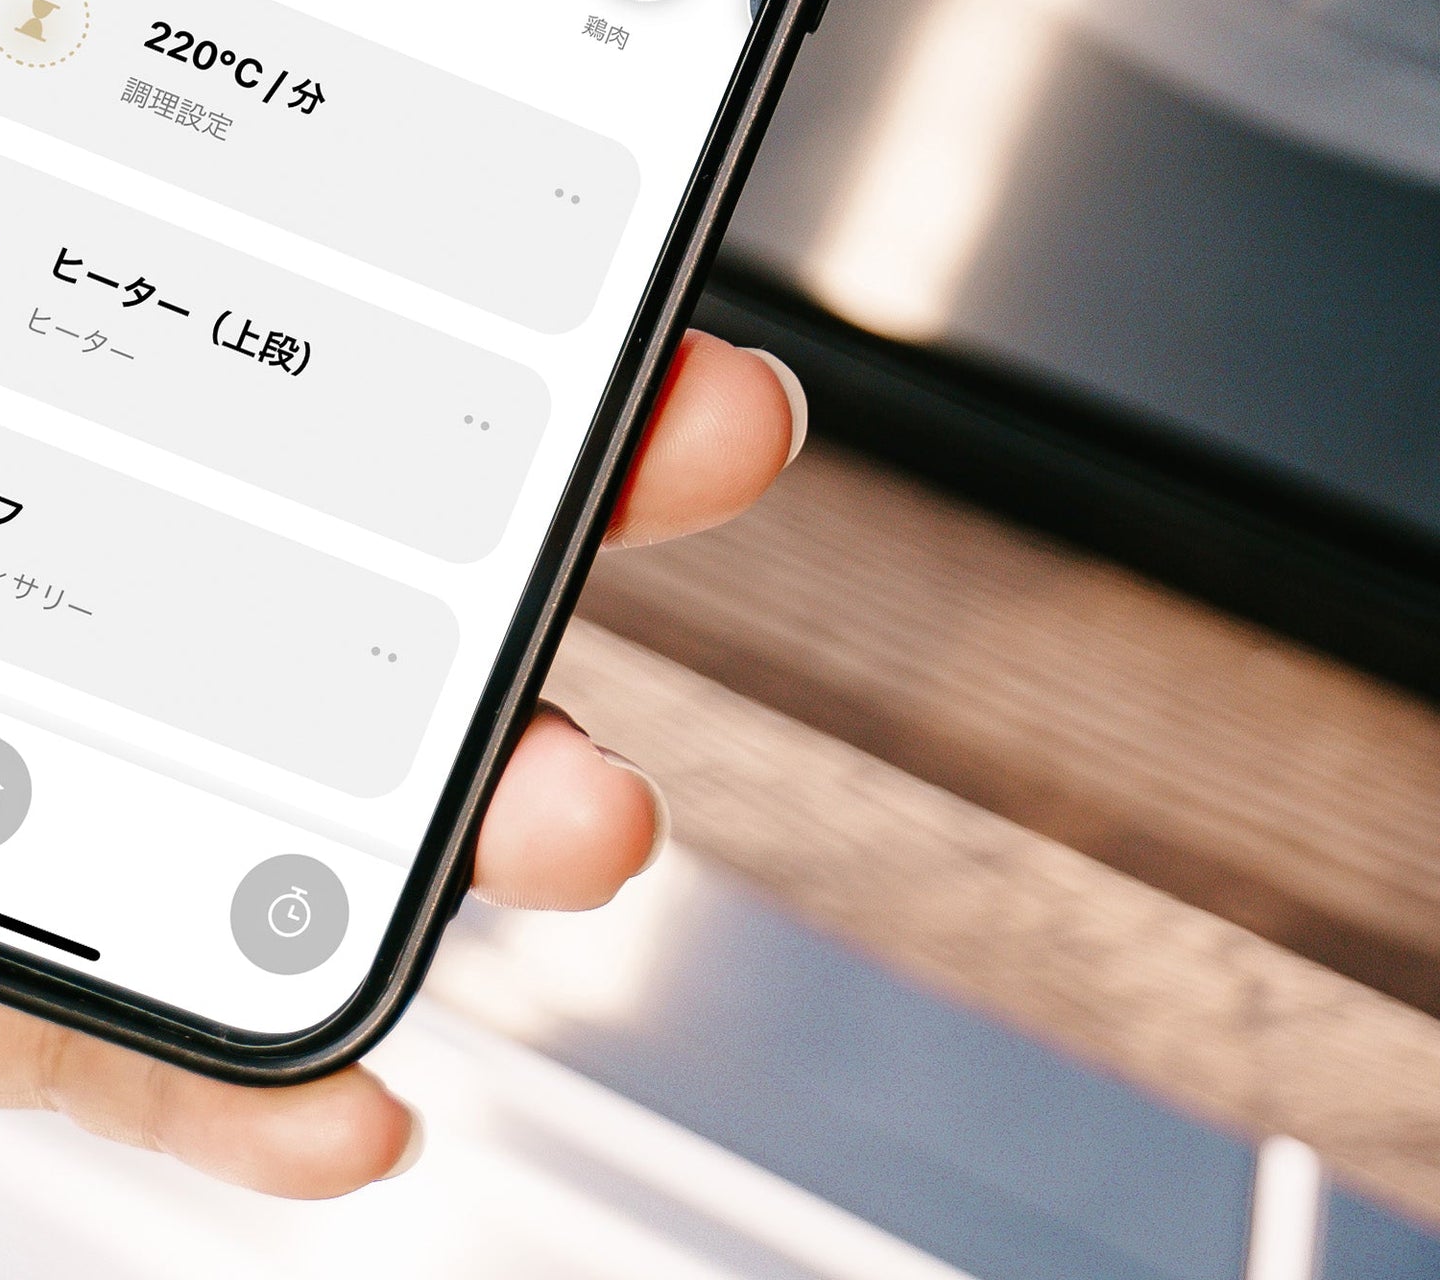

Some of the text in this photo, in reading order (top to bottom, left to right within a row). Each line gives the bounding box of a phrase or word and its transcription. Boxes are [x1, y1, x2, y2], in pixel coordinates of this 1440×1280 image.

[581, 15, 631, 51] 鶏肉
[120, 76, 234, 142] 調理設定
[286, 78, 326, 115] 分
[28, 307, 135, 360] ヒーター
